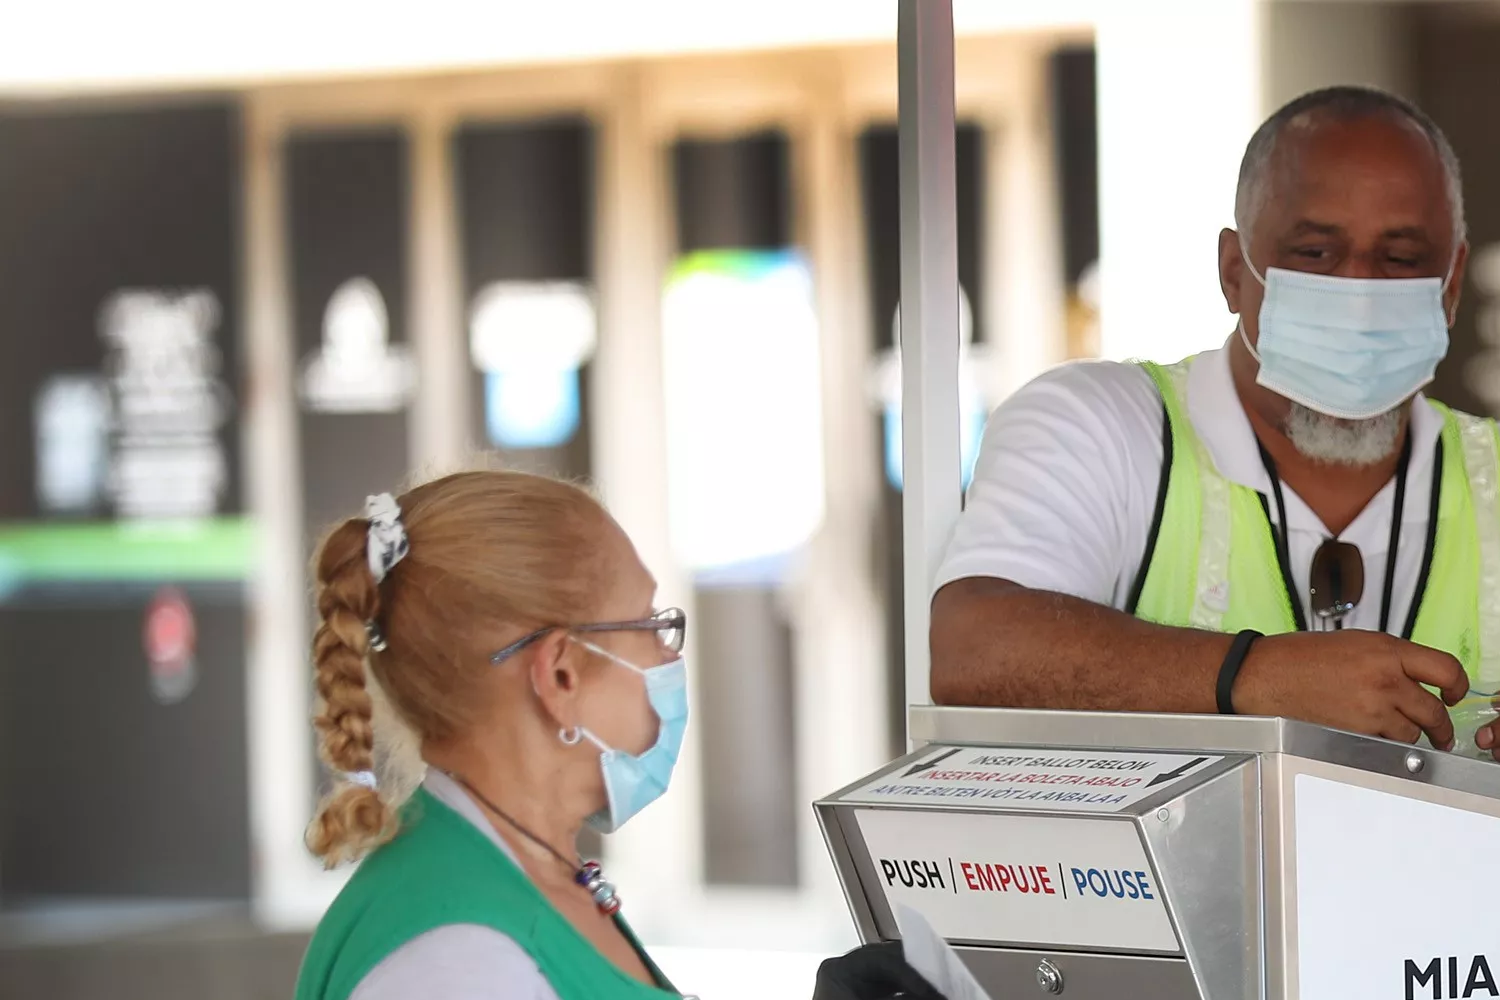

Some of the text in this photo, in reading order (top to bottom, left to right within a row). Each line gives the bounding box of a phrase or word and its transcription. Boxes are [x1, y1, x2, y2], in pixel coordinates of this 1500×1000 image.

[968, 755, 1157, 771] INSERT BALLOT BELOW
[918, 770, 1142, 788] INSERTAR LA BOLETA ABAJO
[880, 859, 1155, 899] PUSH EMPUJE POUSE
